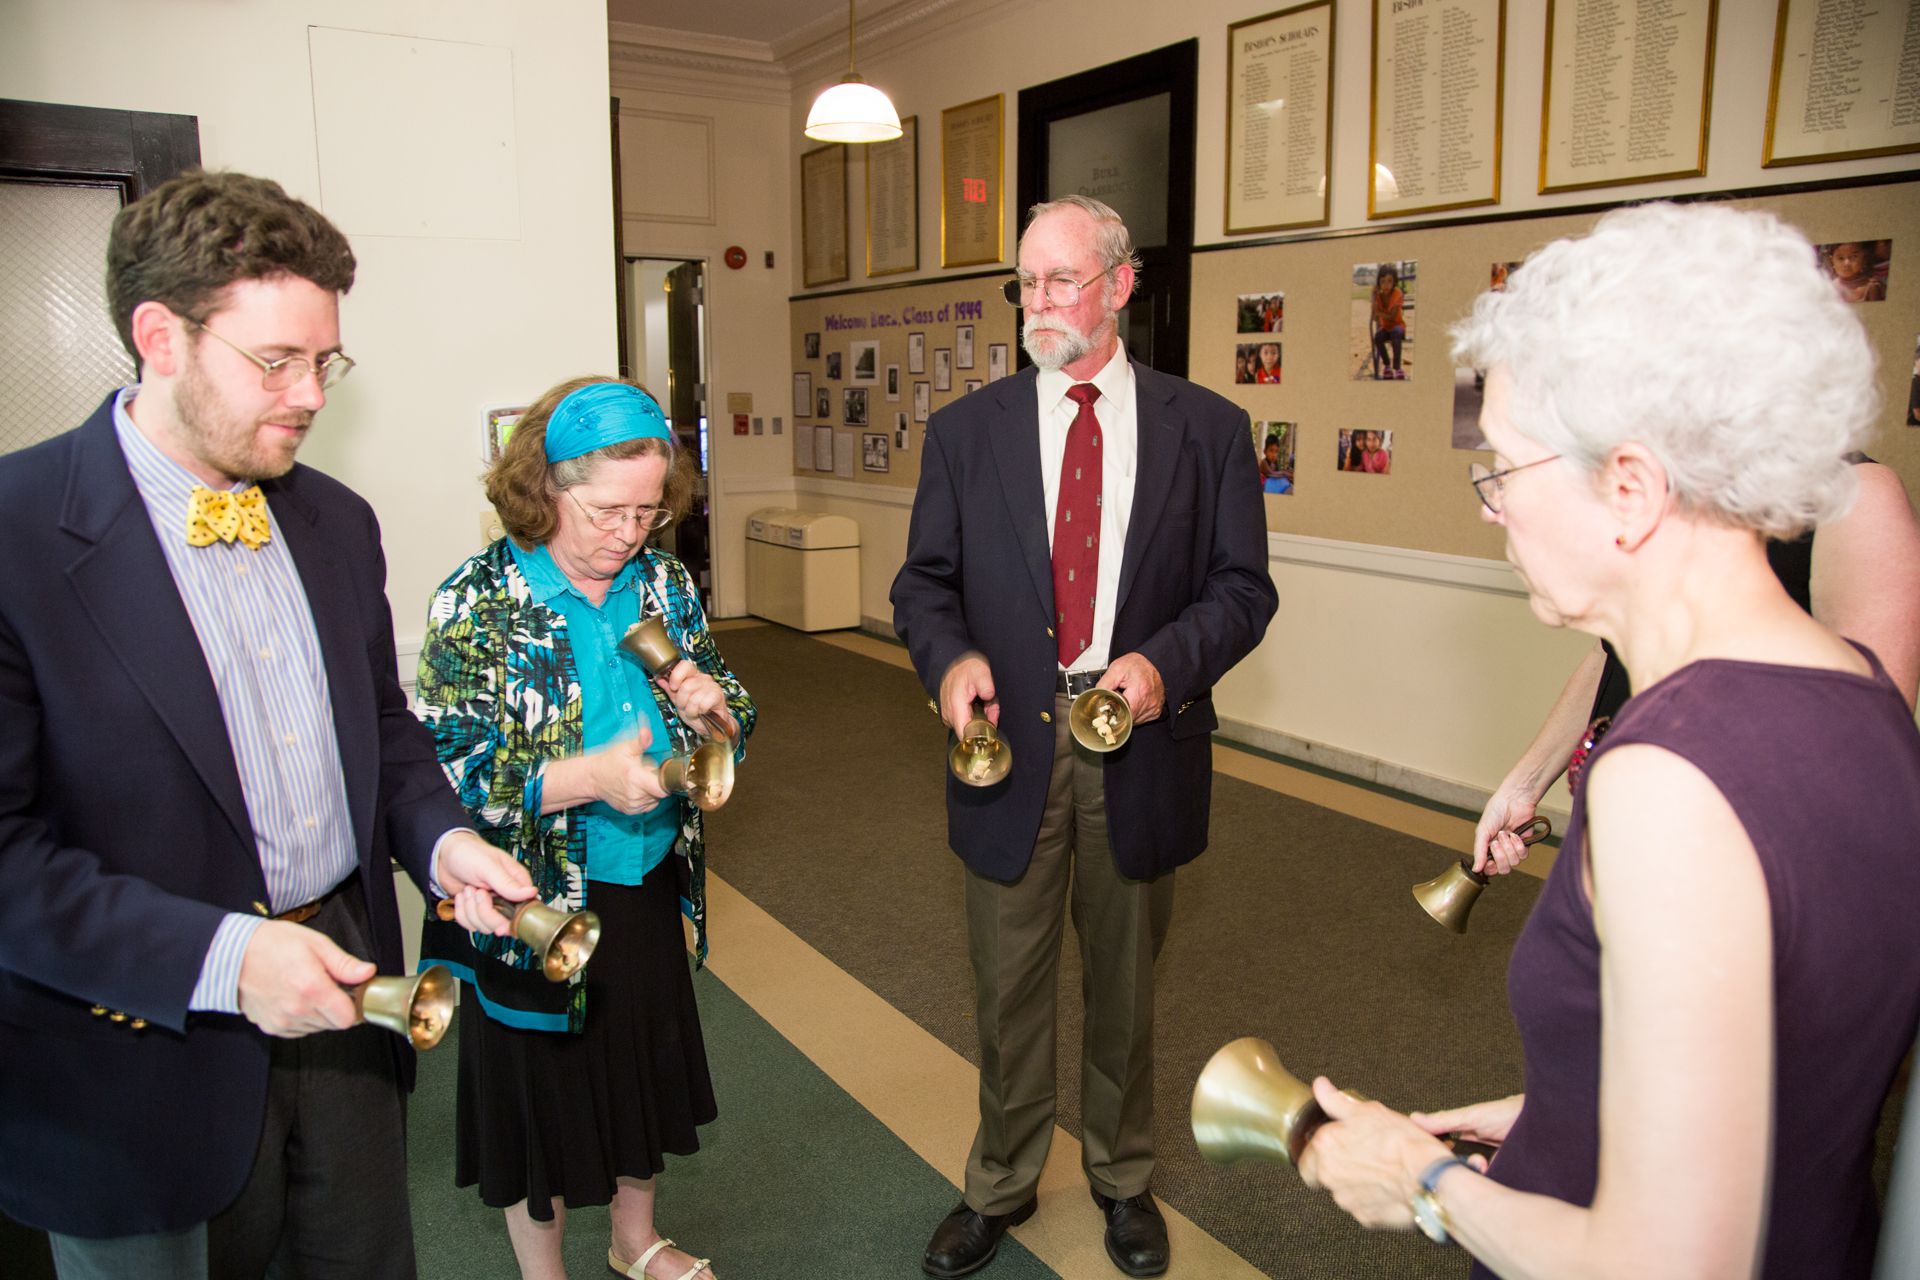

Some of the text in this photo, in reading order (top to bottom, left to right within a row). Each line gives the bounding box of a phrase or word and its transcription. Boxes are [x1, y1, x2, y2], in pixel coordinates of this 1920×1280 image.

[824, 314, 867, 332] Welcome
[902, 305, 934, 325] Class
[937, 303, 949, 322] of
